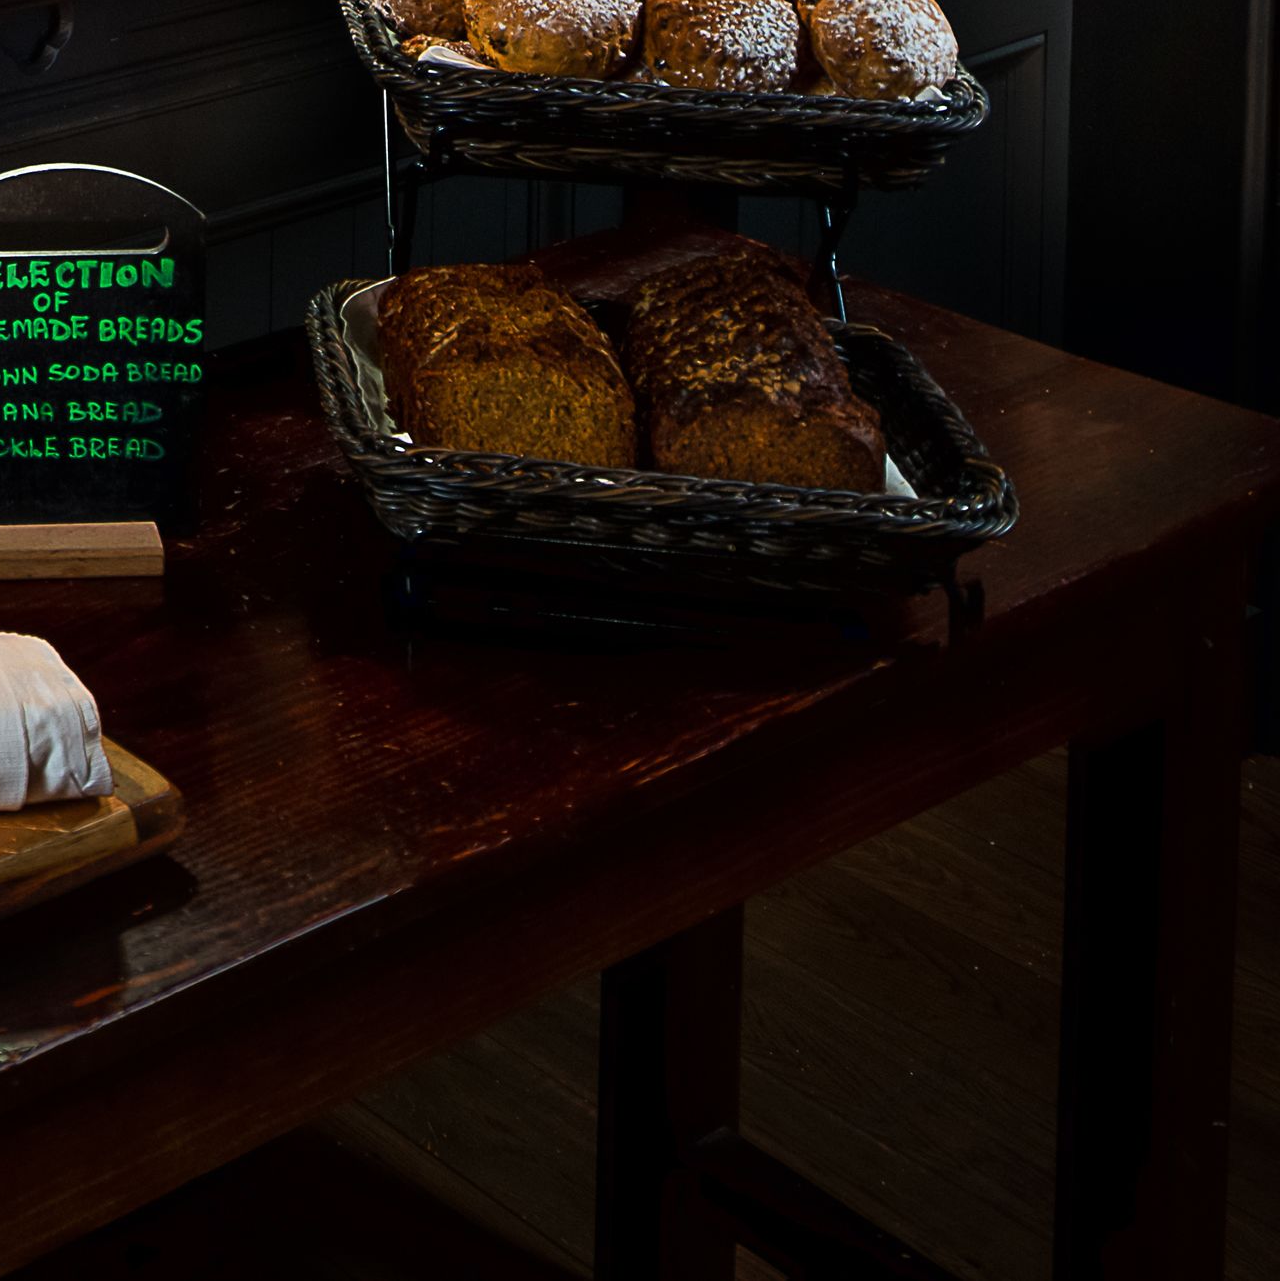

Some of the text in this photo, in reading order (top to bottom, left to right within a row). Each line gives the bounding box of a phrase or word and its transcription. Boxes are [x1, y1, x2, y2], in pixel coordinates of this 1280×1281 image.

[32, 292, 71, 313] OF
[98, 316, 203, 347] BREADS
[48, 363, 119, 384] SODA
[127, 363, 203, 384] BREAD
[68, 401, 163, 422] BREAD
[68, 437, 165, 461] BREAD
